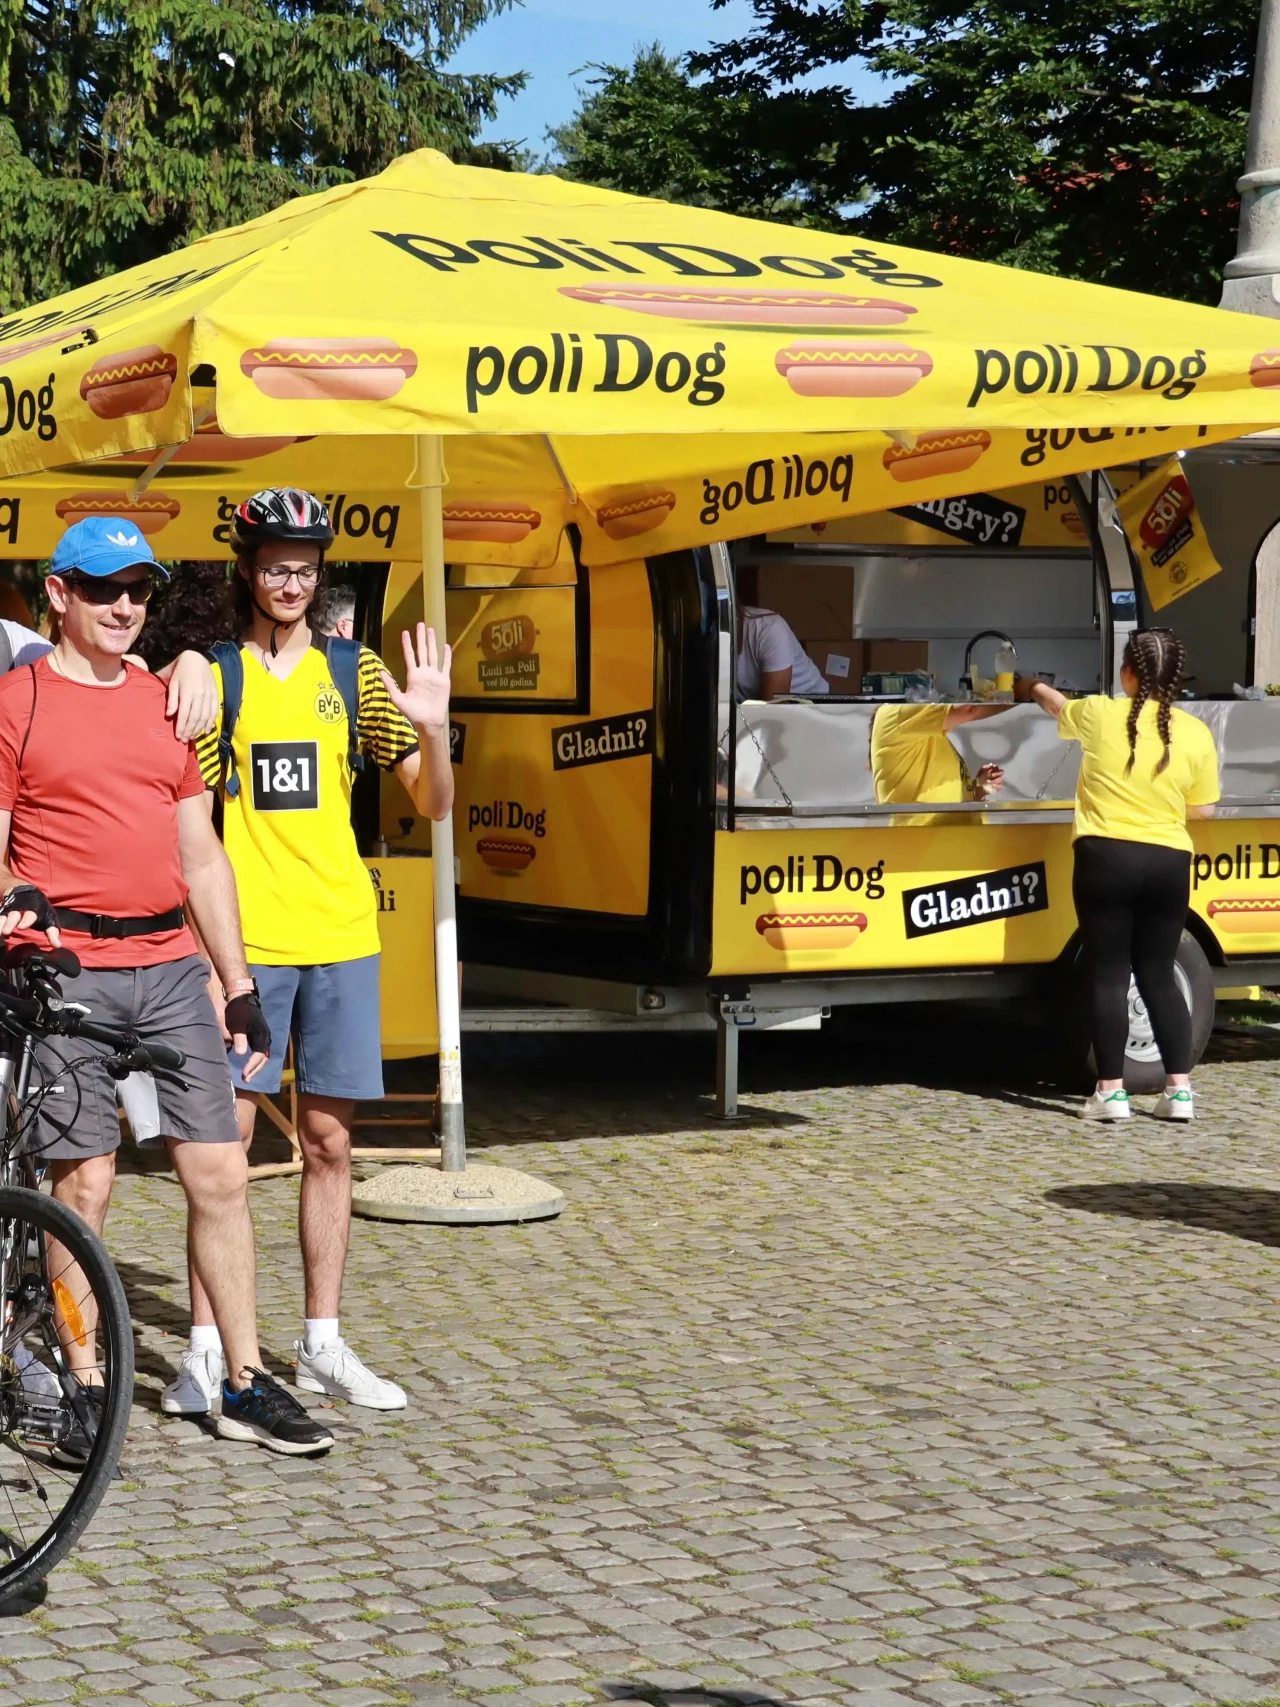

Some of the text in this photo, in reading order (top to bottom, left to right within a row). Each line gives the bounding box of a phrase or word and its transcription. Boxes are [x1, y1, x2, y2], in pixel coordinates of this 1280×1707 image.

[371, 230, 944, 288] poli Dog
[465, 332, 726, 413] poli Dog
[966, 344, 1207, 408] poli Dog
[481, 660, 536, 677] Ludi za Poli
[499, 678, 508, 686] 50
[318, 693, 341, 714] BVB
[325, 712, 334, 720] 09
[557, 718, 647, 762] Gladni?
[257, 757, 310, 793] 1&1
[468, 800, 546, 838] poli Dog
[740, 854, 885, 905] poli Dog
[1193, 844, 1251, 890] poli
[910, 871, 1039, 928] Gladni?
